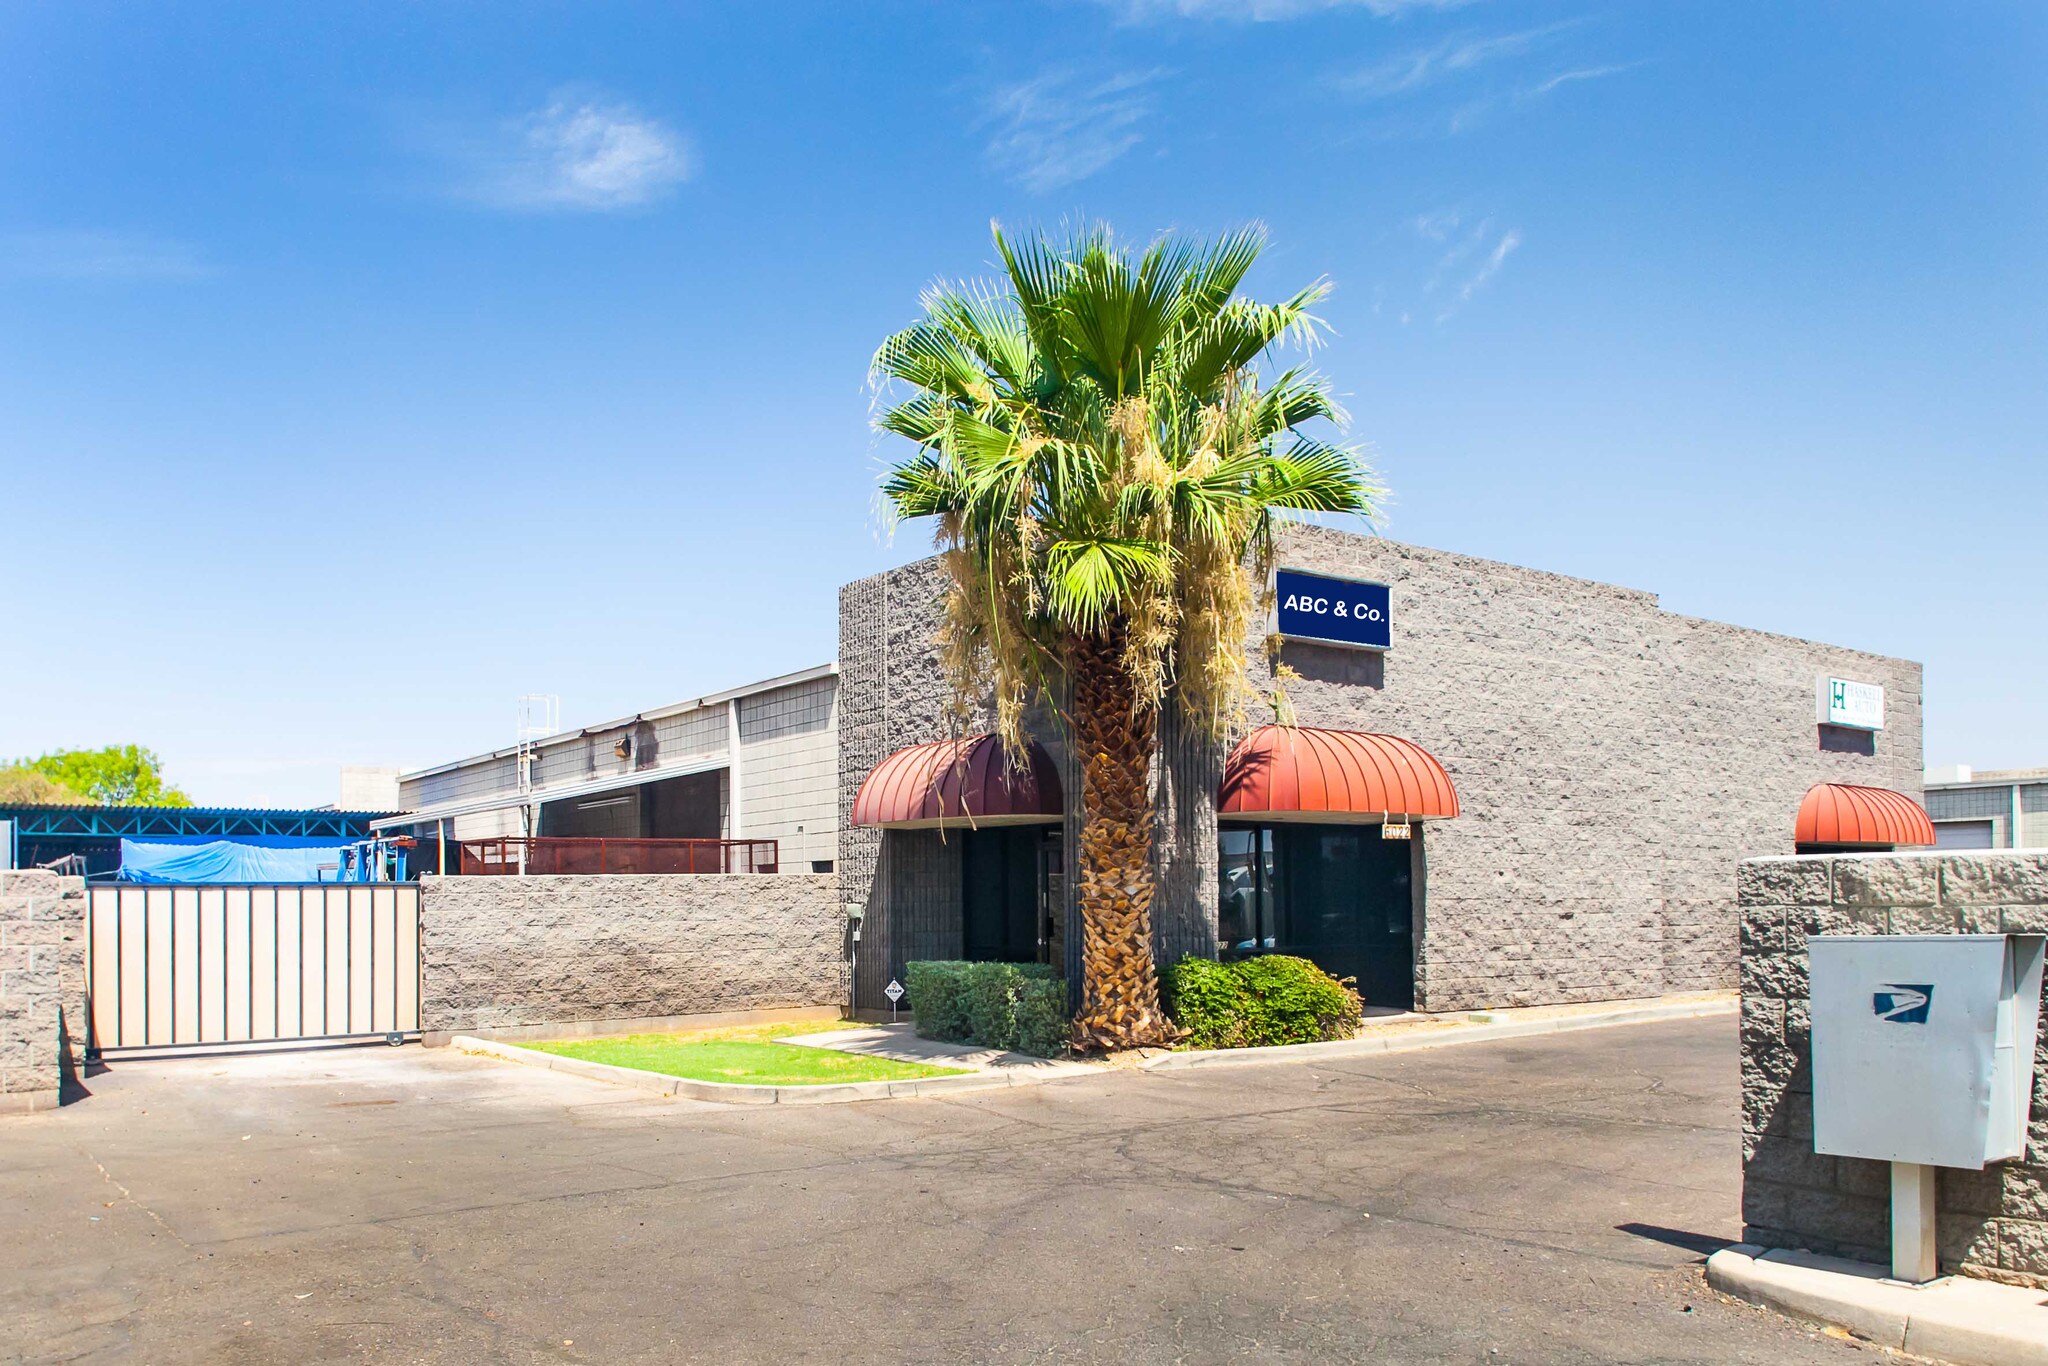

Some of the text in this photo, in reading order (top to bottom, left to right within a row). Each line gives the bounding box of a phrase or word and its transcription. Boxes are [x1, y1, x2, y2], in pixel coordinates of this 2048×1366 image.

[1284, 594, 1385, 622] ABC & Co.
